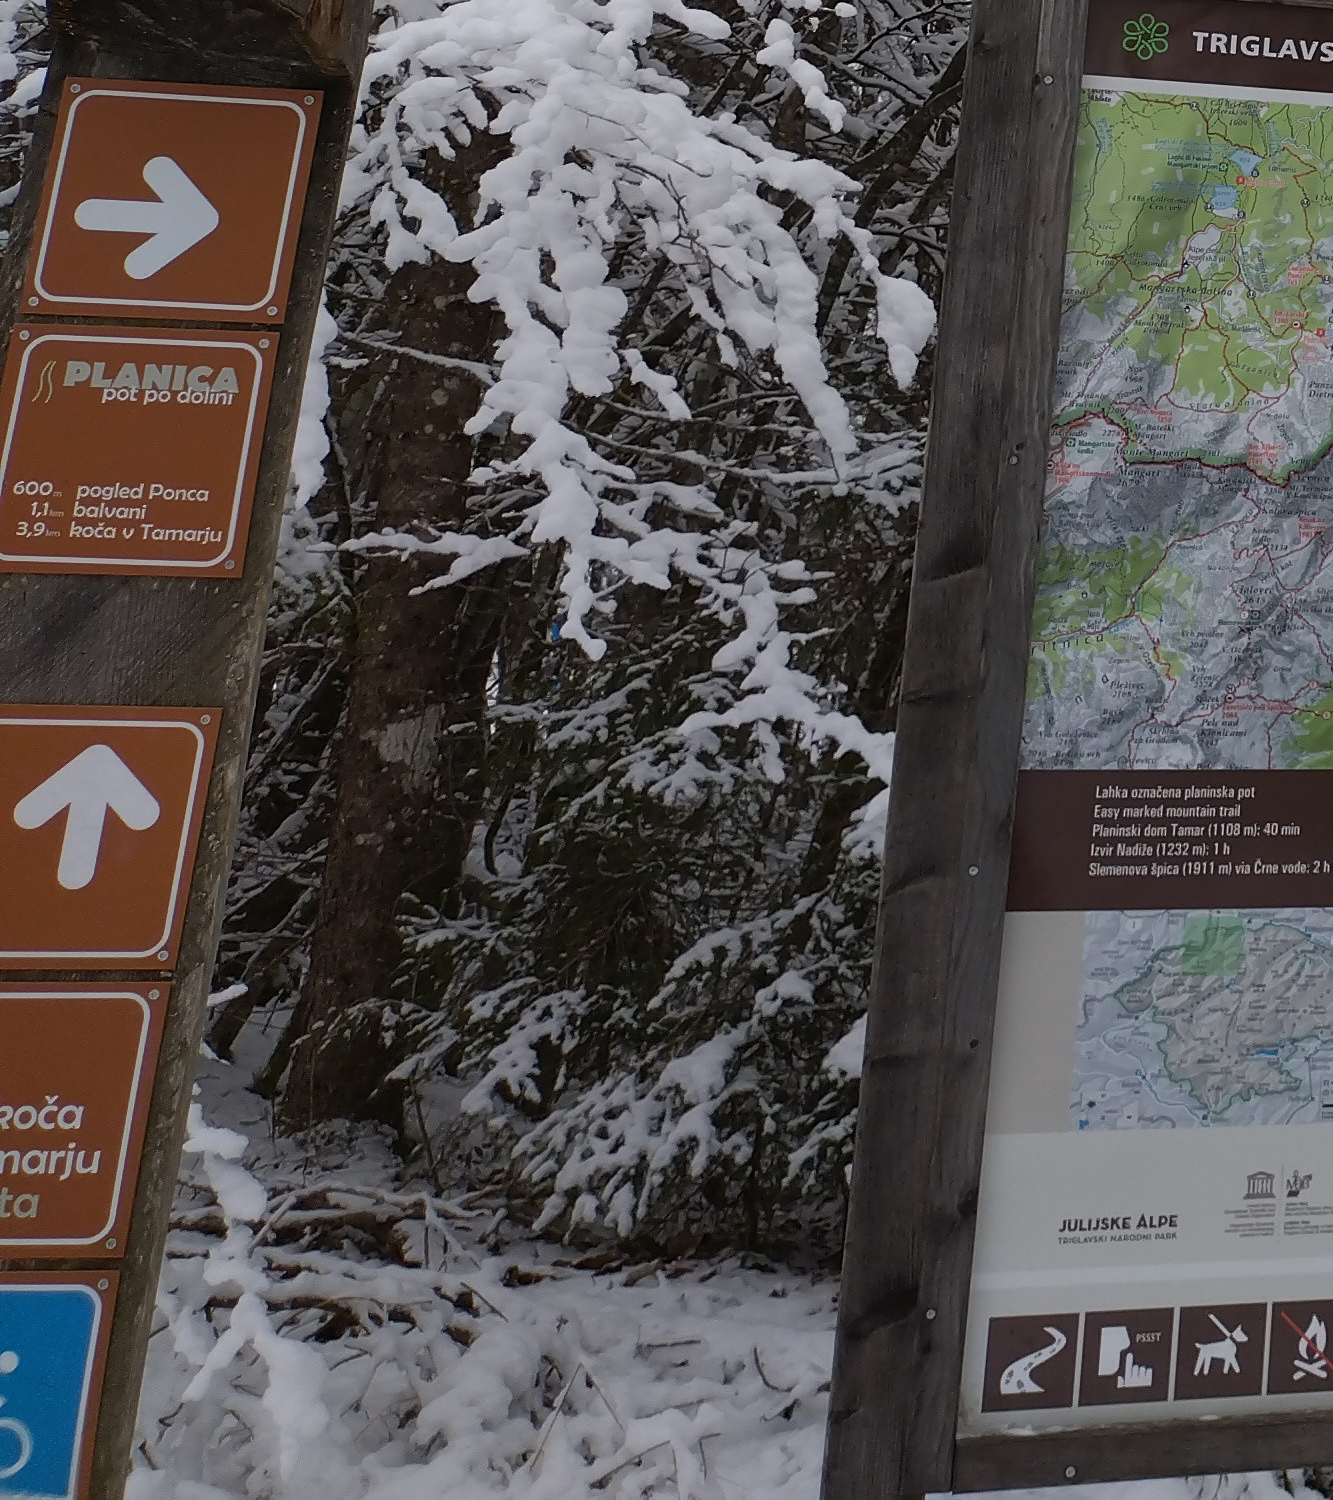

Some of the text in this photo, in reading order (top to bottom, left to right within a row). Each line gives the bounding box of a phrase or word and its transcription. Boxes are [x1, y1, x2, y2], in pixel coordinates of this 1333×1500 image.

[63, 361, 239, 394] PLANICA
[101, 386, 234, 406] pot po dolini
[76, 482, 144, 502] pogled
[149, 484, 210, 502] Ponca
[72, 502, 147, 519] balvani
[69, 521, 117, 539] koča
[122, 526, 134, 539] v
[140, 524, 222, 544] Tamarju
[1095, 785, 1255, 800] Lahka označena planinska pot
[1094, 804, 1240, 820] Easy marked mountain trail
[1092, 822, 1300, 837] Planinski dom Tamar (1108 m): 40 min
[1090, 842, 1230, 856] Izvir Nadiže (1232 m): 1 h
[1088, 862, 1148, 876] Slemenova
[1150, 862, 1179, 877] špica
[1182, 861, 1214, 876] (1911
[1218, 861, 1232, 875] m)
[1234, 861, 1250, 874] via
[1254, 859, 1278, 874] Črne
[1281, 860, 1310, 874] vode:
[1312, 860, 1320, 873] 2
[1322, 860, 1330, 873] h
[1058, 1213, 1179, 1232] JULIJSKE ALPE
[1057, 1231, 1178, 1245] TRIGLAVSKI NARODNI PARK
